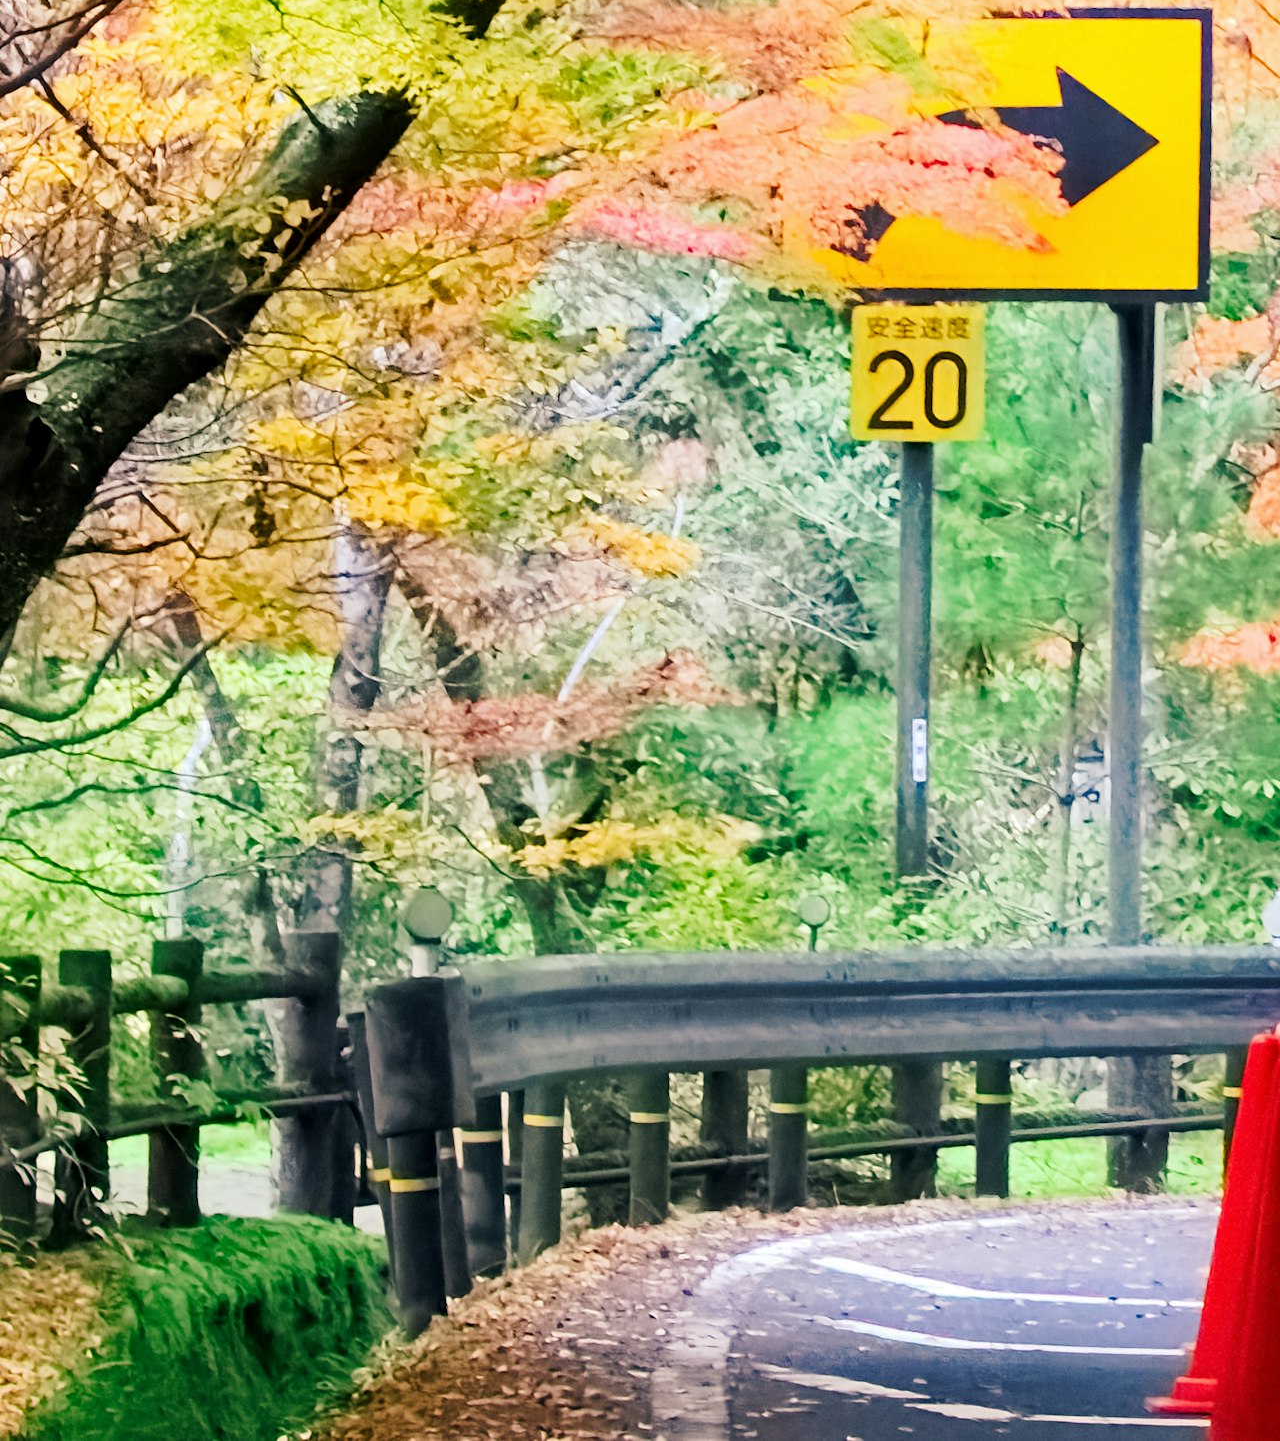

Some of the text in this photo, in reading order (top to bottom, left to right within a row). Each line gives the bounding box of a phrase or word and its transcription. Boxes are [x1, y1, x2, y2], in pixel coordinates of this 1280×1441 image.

[866, 316, 970, 340] 安全速度
[867, 349, 967, 430] 20
